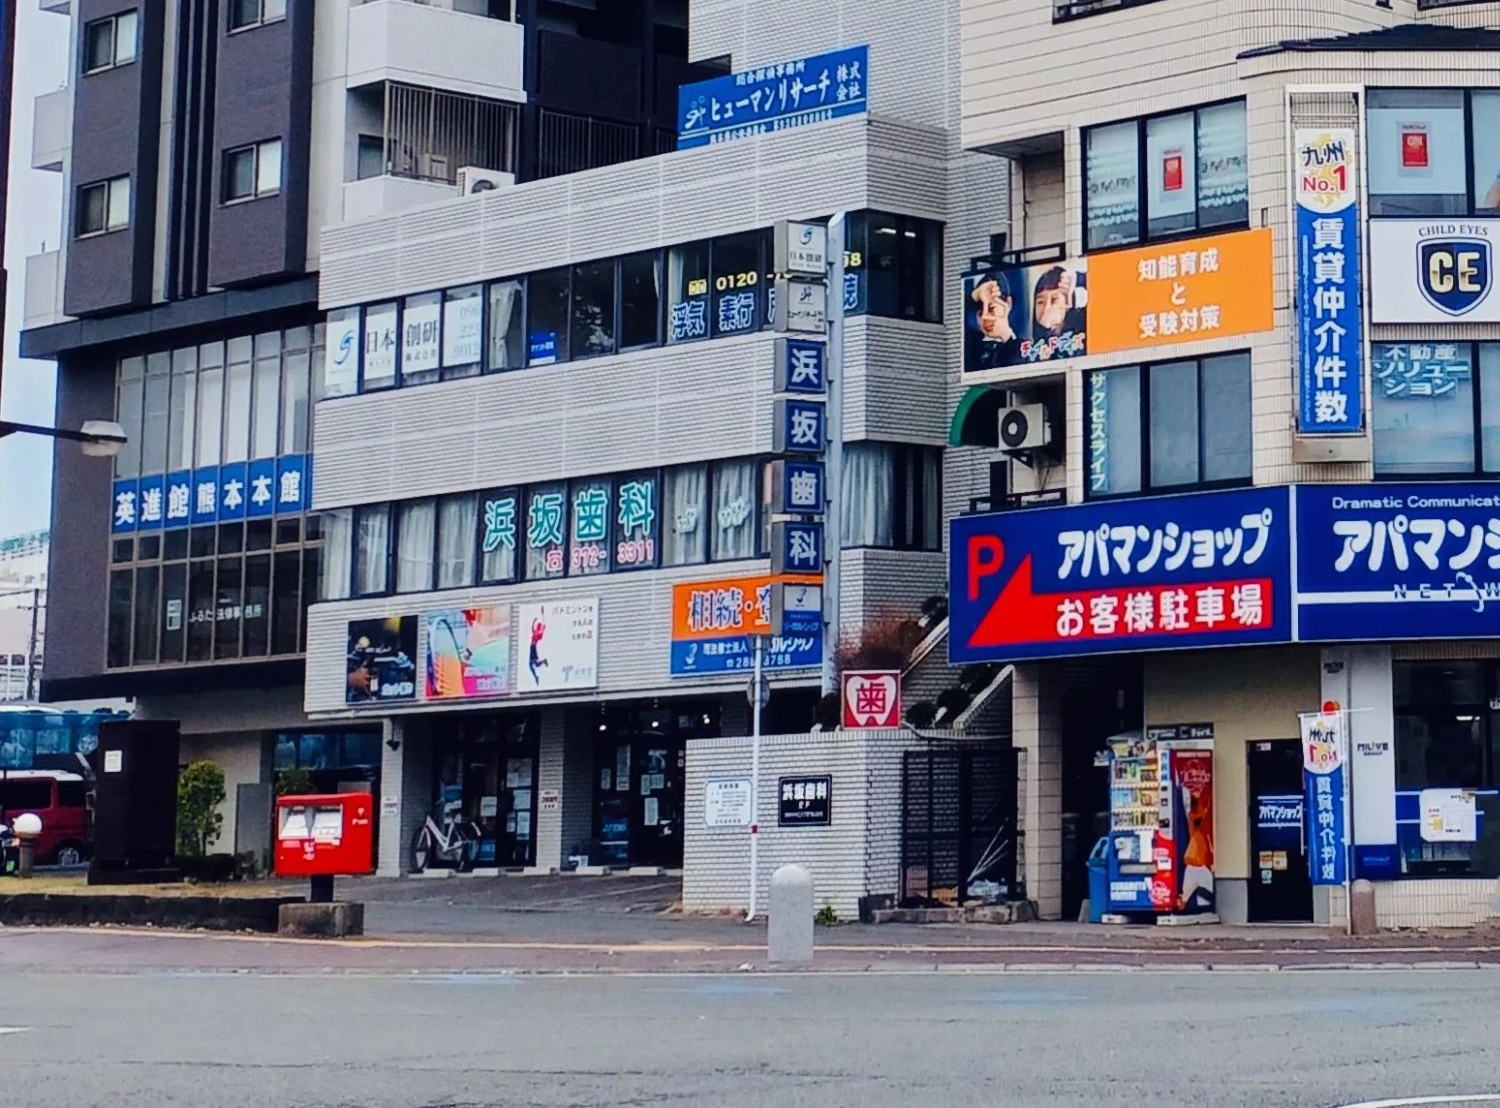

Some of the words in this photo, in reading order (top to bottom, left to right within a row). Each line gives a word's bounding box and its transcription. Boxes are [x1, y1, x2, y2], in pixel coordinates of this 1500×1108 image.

[711, 68, 831, 122] ヒューマンリサーチ
[1302, 141, 1345, 167] 九州
[1302, 164, 1347, 192] No.1
[1418, 224, 1456, 237] CHILD
[1459, 224, 1489, 237] EYES
[716, 270, 758, 291] 0120
[1138, 248, 1219, 282] 知能育成
[1429, 251, 1481, 292] CE
[1170, 282, 1187, 306] と
[718, 292, 755, 332] 素行
[1139, 305, 1220, 340] 受験対策
[1312, 217, 1348, 424] 賃貸仲介件数
[365, 327, 395, 354] 日本
[1385, 343, 1457, 361] 不動産
[1384, 377, 1456, 396] ション
[1089, 372, 1107, 491] サクセスライフ
[788, 348, 819, 566] 浜坂歯科
[114, 469, 302, 526] 英進館熊本本館
[1332, 495, 1404, 509] Dramatic
[483, 481, 655, 553] 浜坂歯科
[1057, 507, 1273, 580] アパマンショップ
[967, 534, 1005, 601] P
[1056, 583, 1263, 637] お客様駐車場
[855, 681, 887, 714] 歯
[1258, 804, 1303, 821] アパマンショップ
